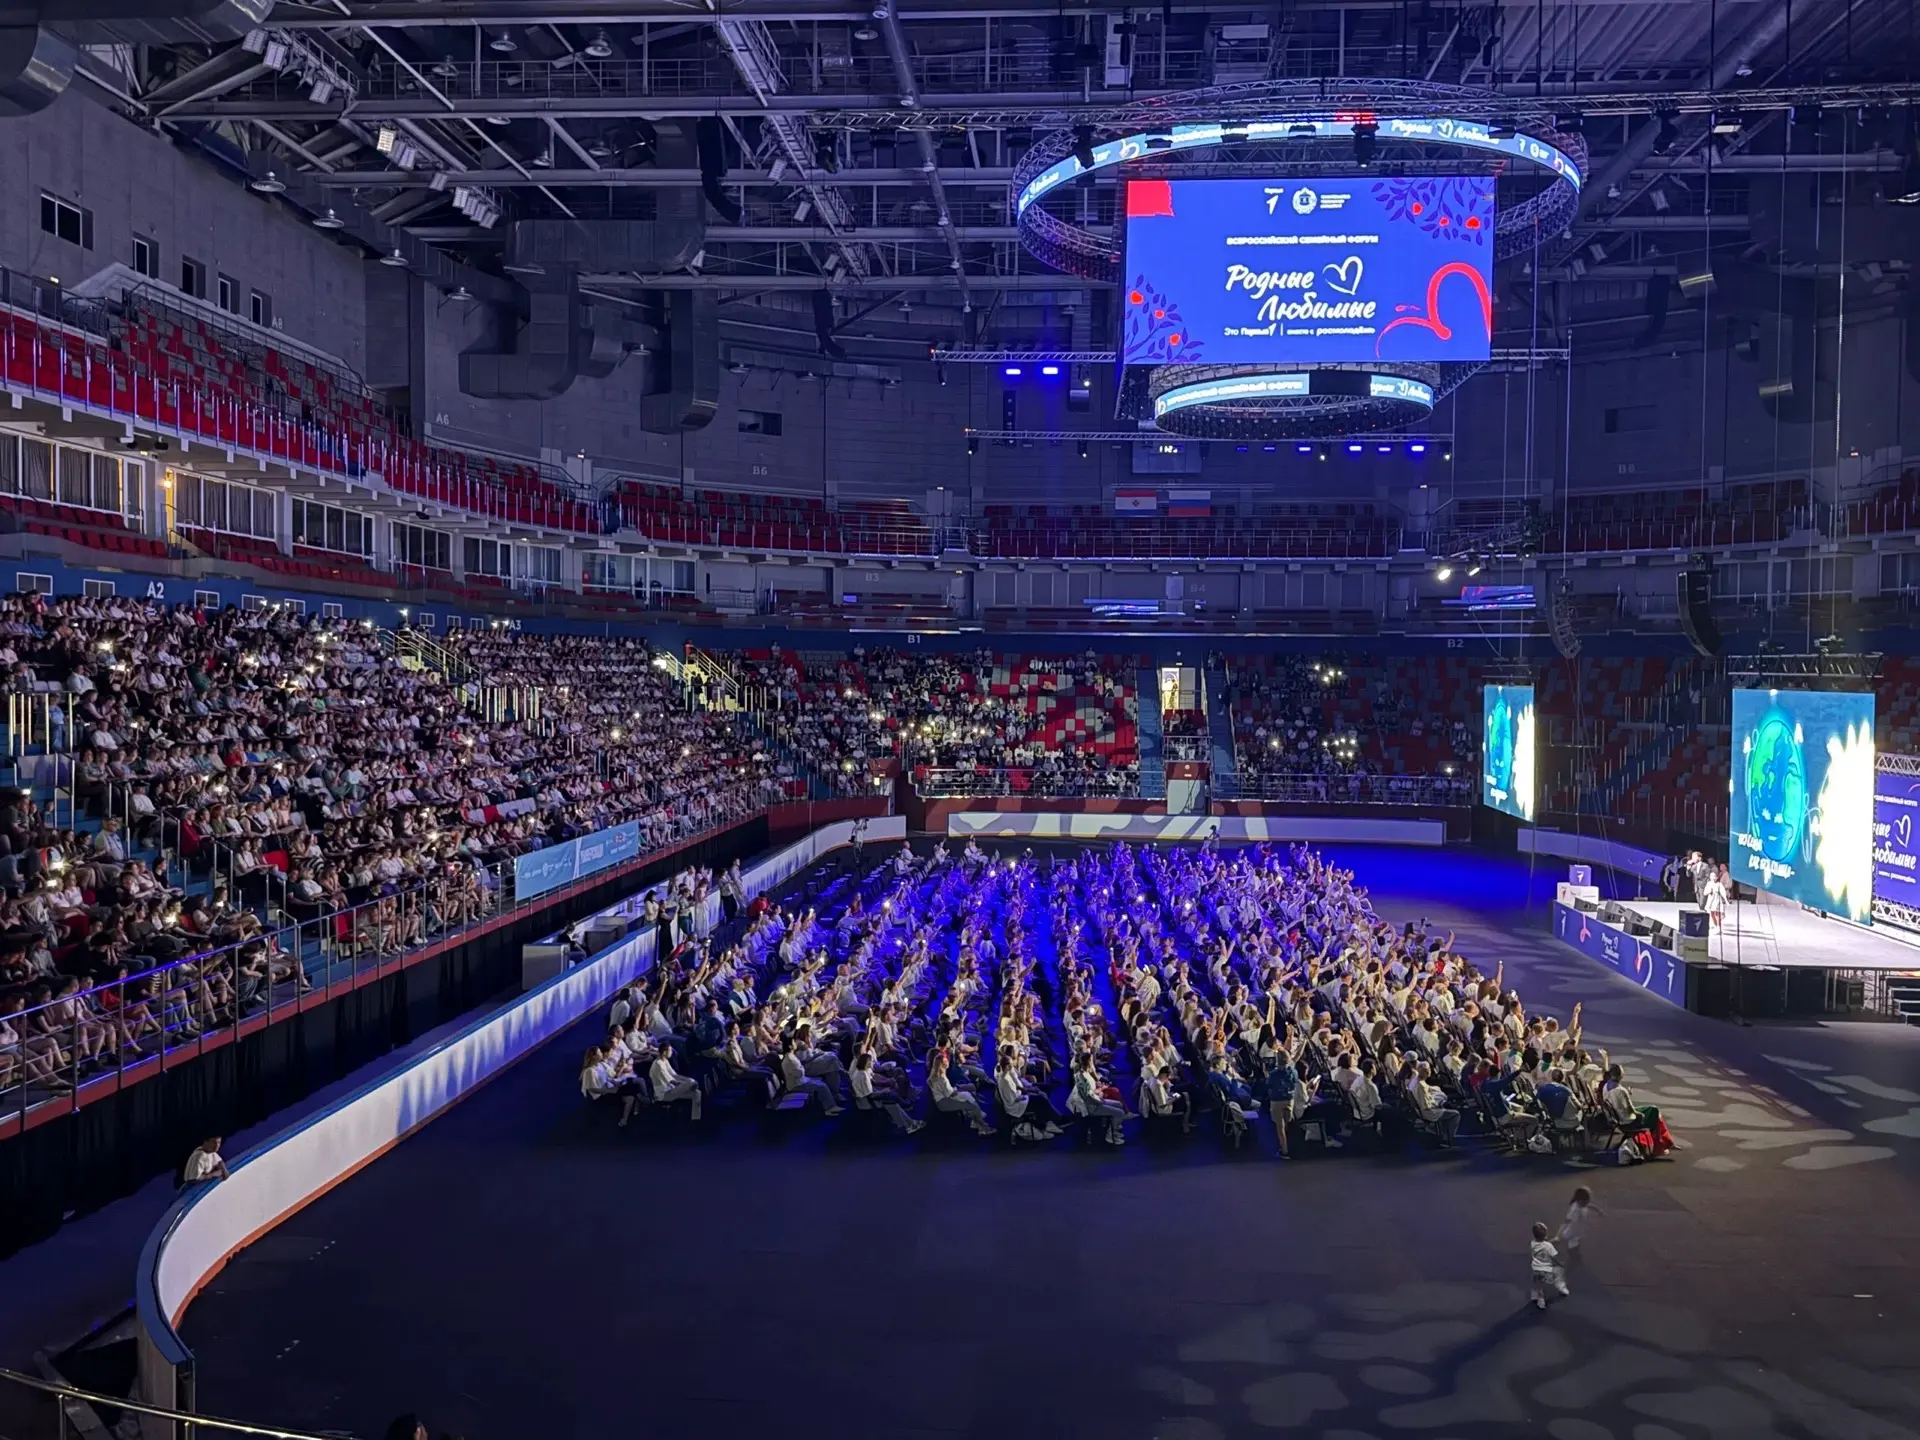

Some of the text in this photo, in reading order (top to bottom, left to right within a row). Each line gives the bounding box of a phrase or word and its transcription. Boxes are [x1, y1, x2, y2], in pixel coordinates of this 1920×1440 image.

[1225, 264, 1315, 299] Родные
[1257, 291, 1377, 321] Любимые
[147, 581, 164, 599] A2
